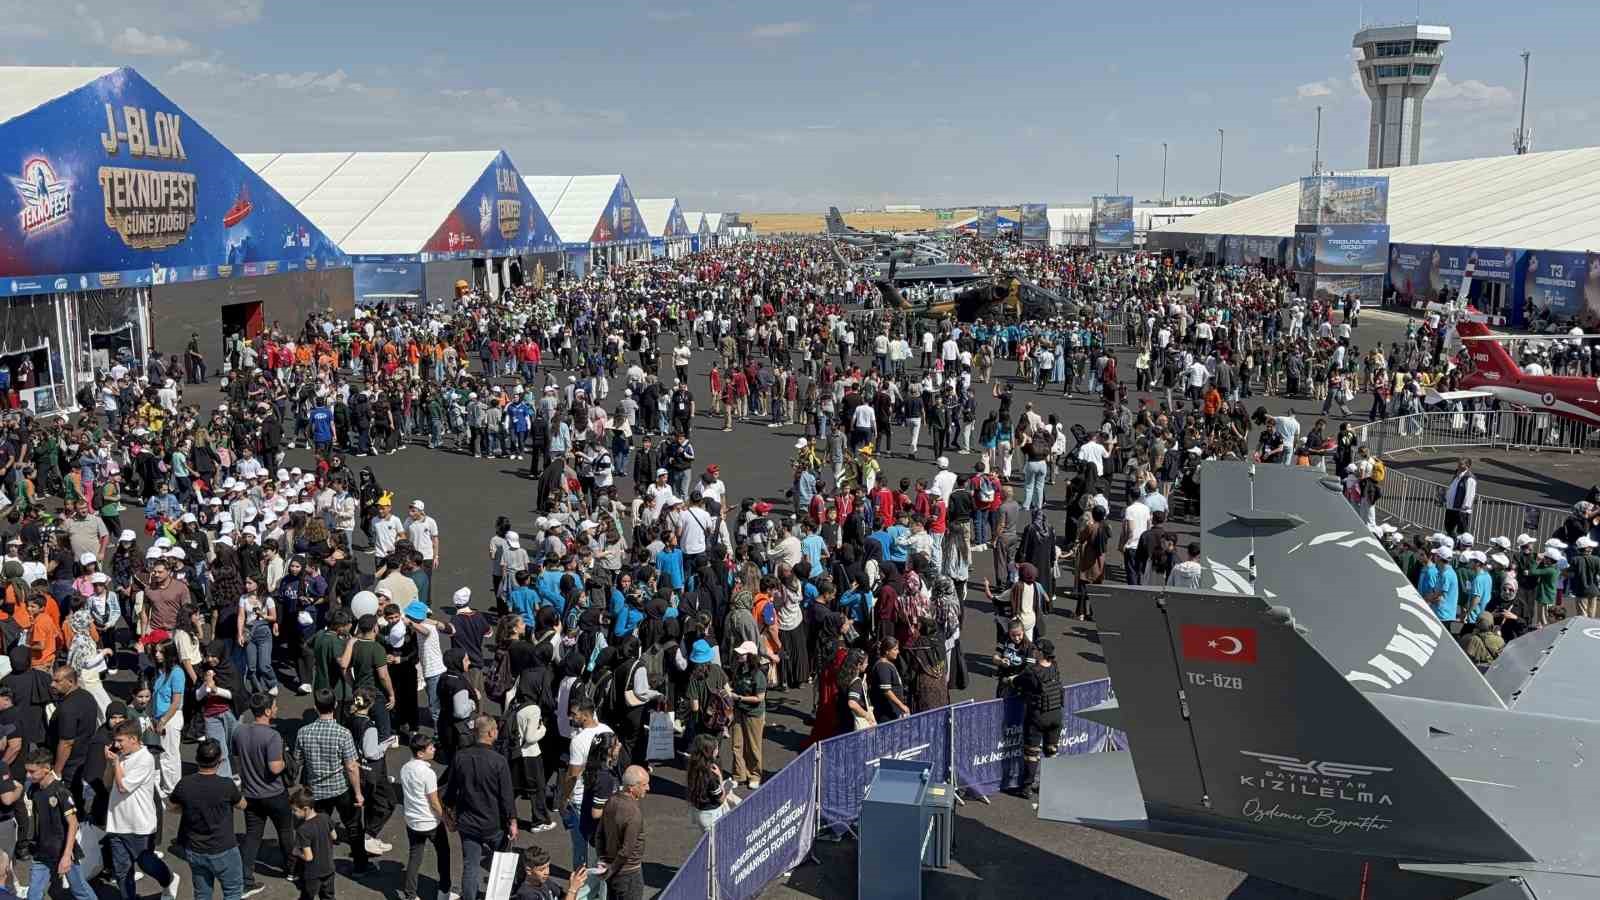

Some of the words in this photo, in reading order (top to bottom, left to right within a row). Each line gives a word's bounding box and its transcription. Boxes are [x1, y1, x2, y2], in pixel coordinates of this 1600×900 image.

[101, 103, 187, 160] J-BLOK
[102, 169, 196, 209] TEKNOFEST
[21, 191, 71, 229] TEKNOFEST
[125, 210, 186, 235] GÜNEYDOĞU
[1550, 264, 1563, 277] T3
[1186, 672, 1243, 690] TC-ÖZB
[1240, 775, 1393, 805] KIZILELMA
[1265, 770, 1366, 789] BAYRAKTAR
[767, 824, 780, 842] AND
[735, 847, 770, 885] UNMANNED
